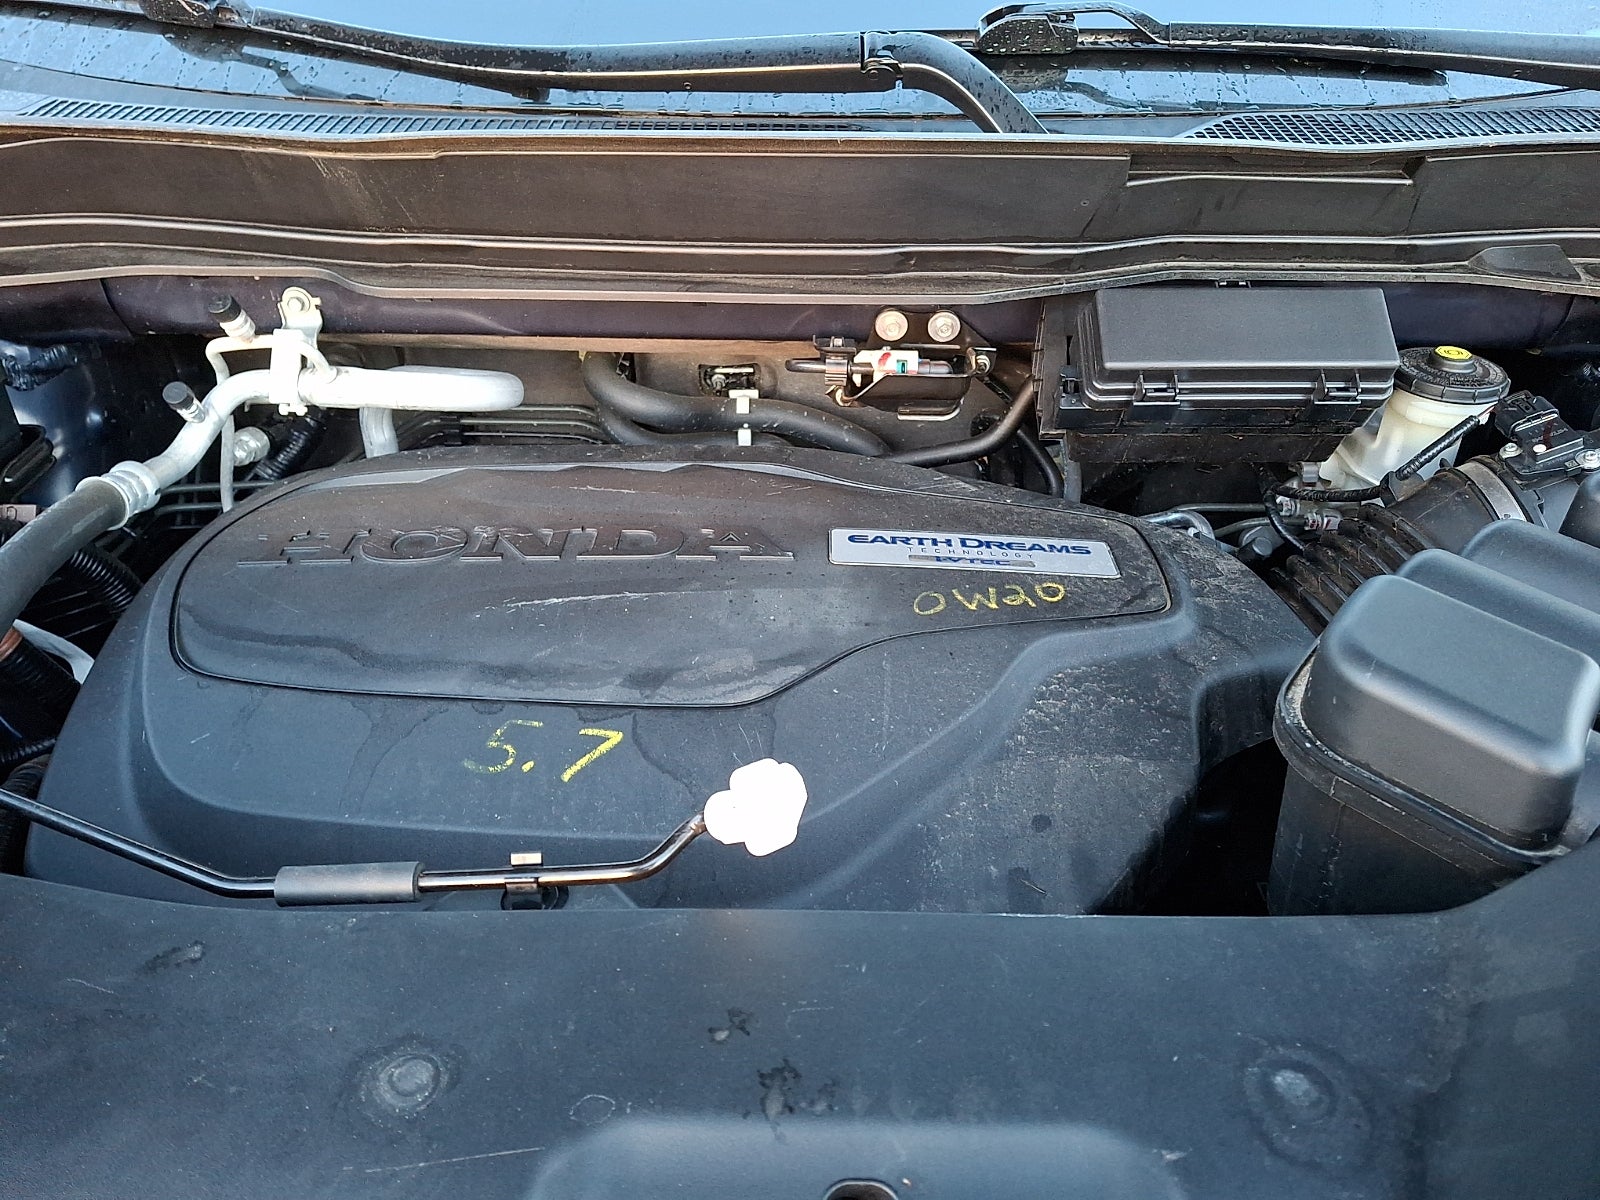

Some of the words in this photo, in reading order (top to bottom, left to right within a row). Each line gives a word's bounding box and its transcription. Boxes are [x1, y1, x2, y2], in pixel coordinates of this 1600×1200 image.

[236, 527, 795, 566] HONDA
[847, 534, 953, 548] EARTH
[958, 537, 1091, 555] DREAMS
[908, 546, 1034, 559] TECHNOLOGY
